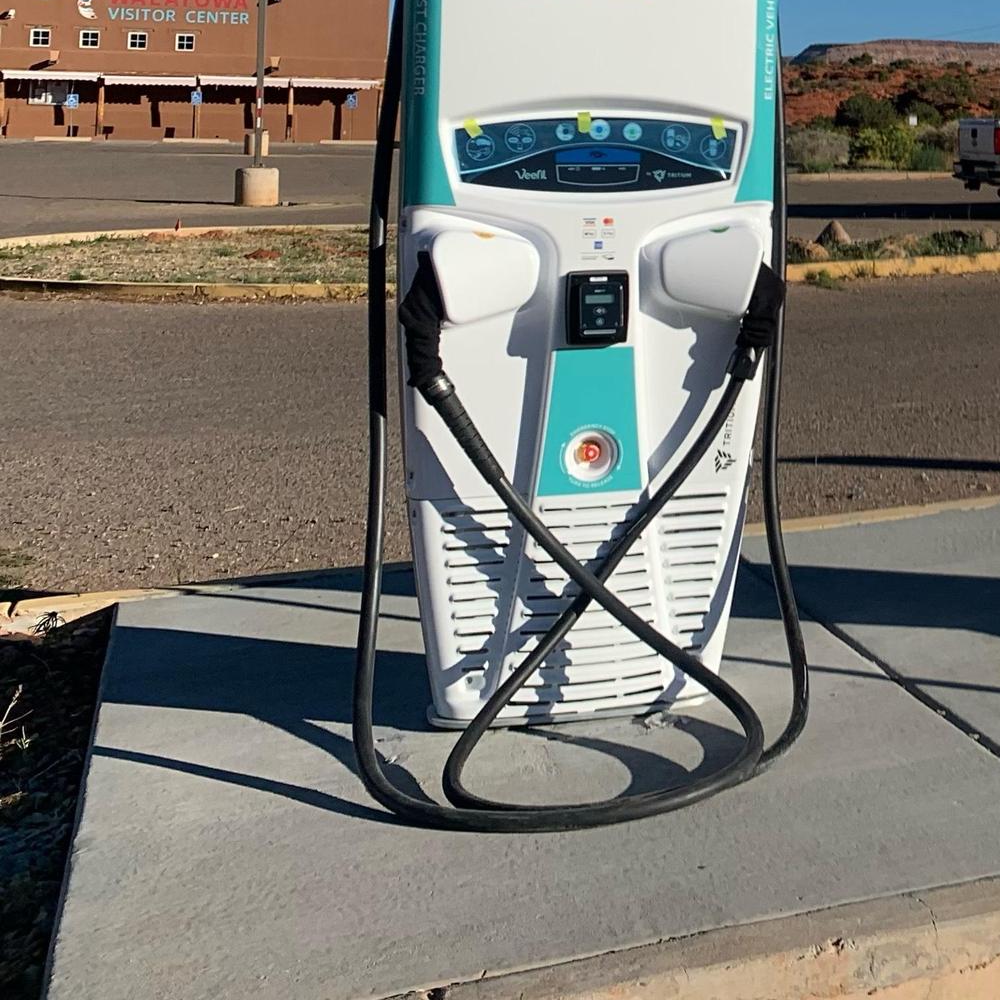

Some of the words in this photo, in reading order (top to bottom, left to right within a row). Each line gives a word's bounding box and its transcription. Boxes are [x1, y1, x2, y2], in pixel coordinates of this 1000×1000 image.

[108, 7, 176, 22] VISITOR
[185, 10, 249, 25] CENTER
[414, 22, 427, 96] CHARGER
[764, 34, 775, 100] ELECTRIC
[722, 406, 736, 446] TRITIU
